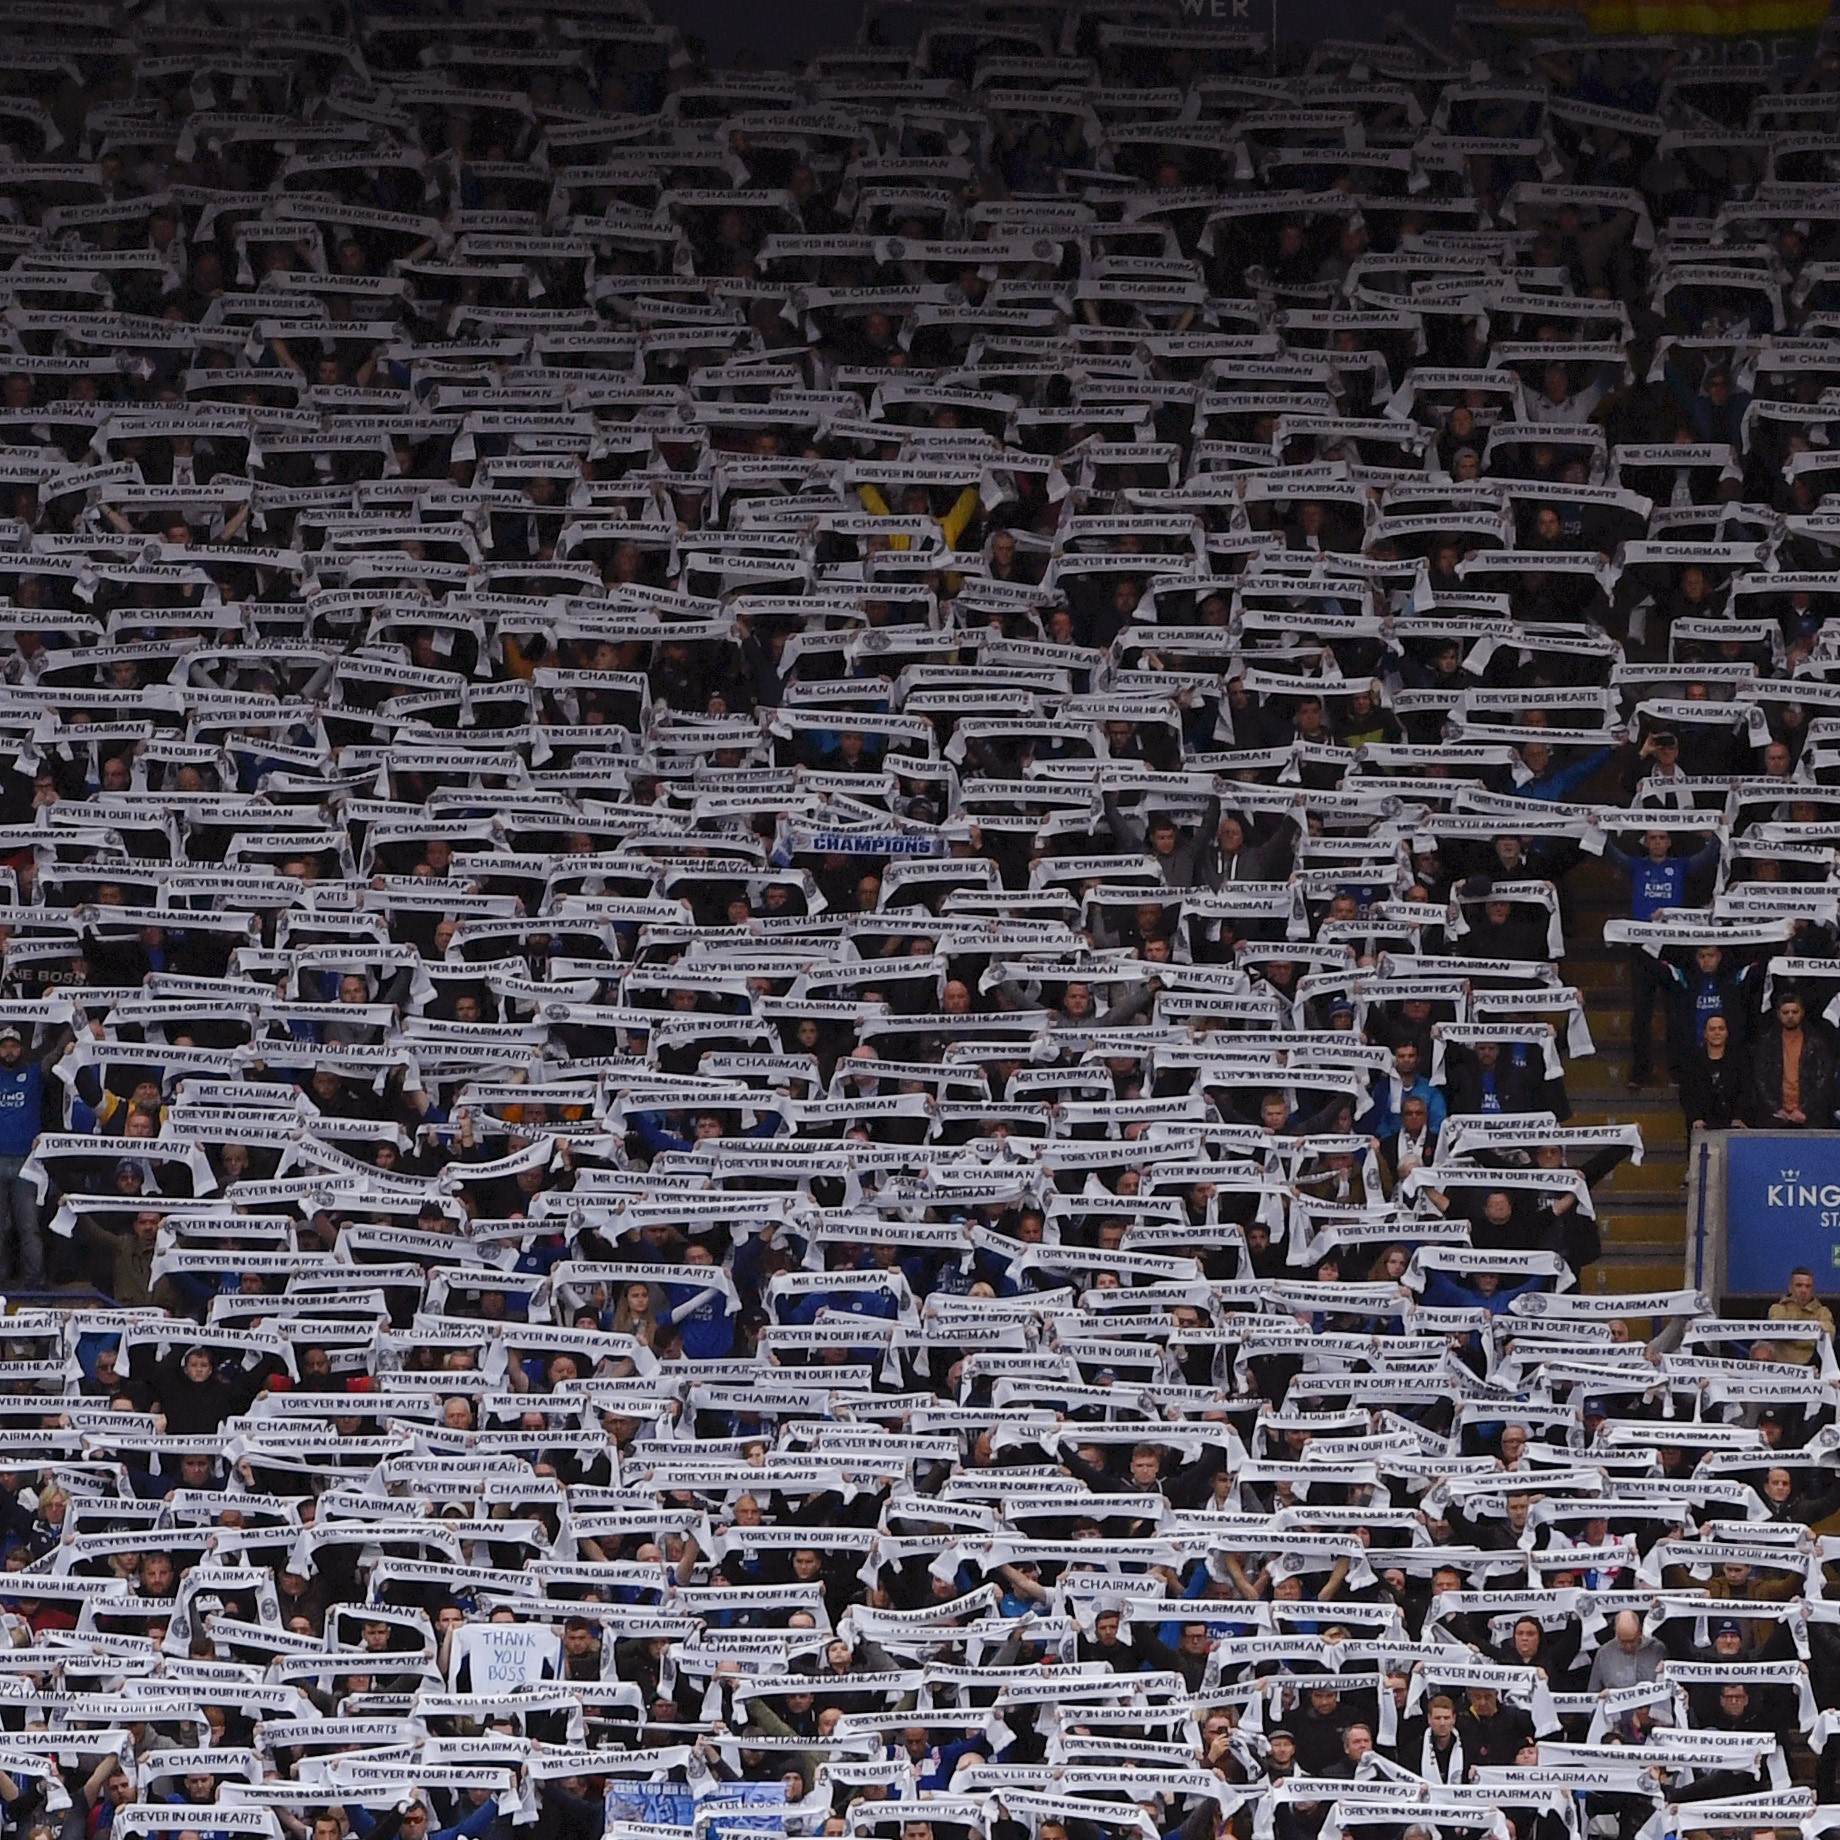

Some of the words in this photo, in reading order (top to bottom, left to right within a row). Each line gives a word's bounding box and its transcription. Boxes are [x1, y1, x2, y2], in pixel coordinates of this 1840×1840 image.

[581, 523, 598, 531] MR
[602, 522, 671, 533] CHAIRMAN
[709, 557, 724, 565] MR
[728, 557, 795, 570] CHAIRMAN
[814, 838, 930, 852] CHAMPIONS
[358, 1232, 375, 1241] MR
[379, 1233, 453, 1249] CHAIRMAN
[229, 1297, 278, 1309] FOREVER
[281, 1297, 294, 1306] IN
[297, 1295, 321, 1306] OUR
[325, 1294, 381, 1306] HEARTS
[1158, 1604, 1176, 1612] MR
[1180, 1604, 1255, 1614] CHAIRMAN
[1343, 1643, 1361, 1652] MR
[1366, 1643, 1445, 1655] CHAIRMAN
[1506, 1772, 1526, 1782] MR
[1531, 1772, 1607, 1783] CHAIRMAN
[1453, 1790, 1475, 1799] MR
[1478, 1789, 1552, 1800] CHAIRMAN
